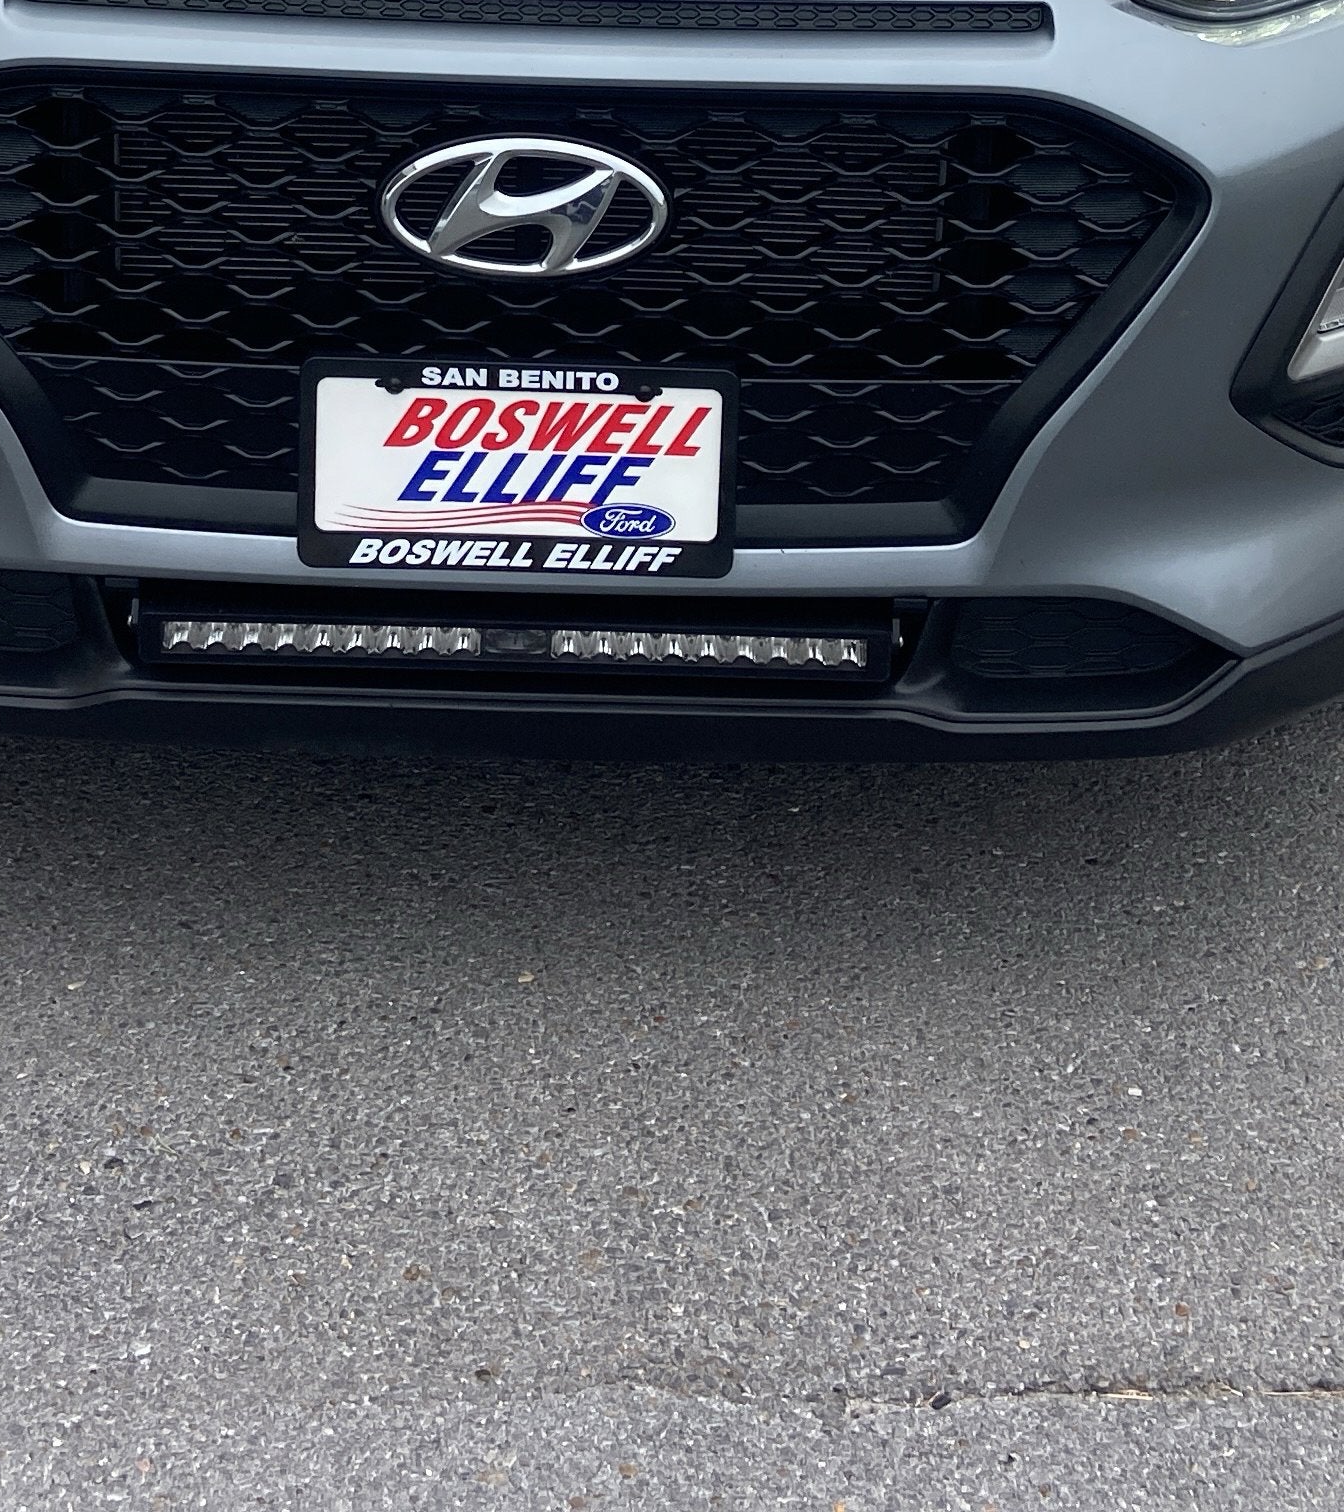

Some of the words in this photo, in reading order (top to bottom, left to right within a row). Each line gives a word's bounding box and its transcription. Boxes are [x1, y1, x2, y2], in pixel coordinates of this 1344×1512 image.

[421, 367, 487, 387] SAN
[499, 369, 619, 391] BENITO
[384, 398, 712, 456] BOSWELL
[397, 451, 654, 505] ELLIFF
[599, 508, 656, 533] Ford
[349, 538, 534, 566] BOSWELL
[543, 543, 682, 572] ELLIFF
